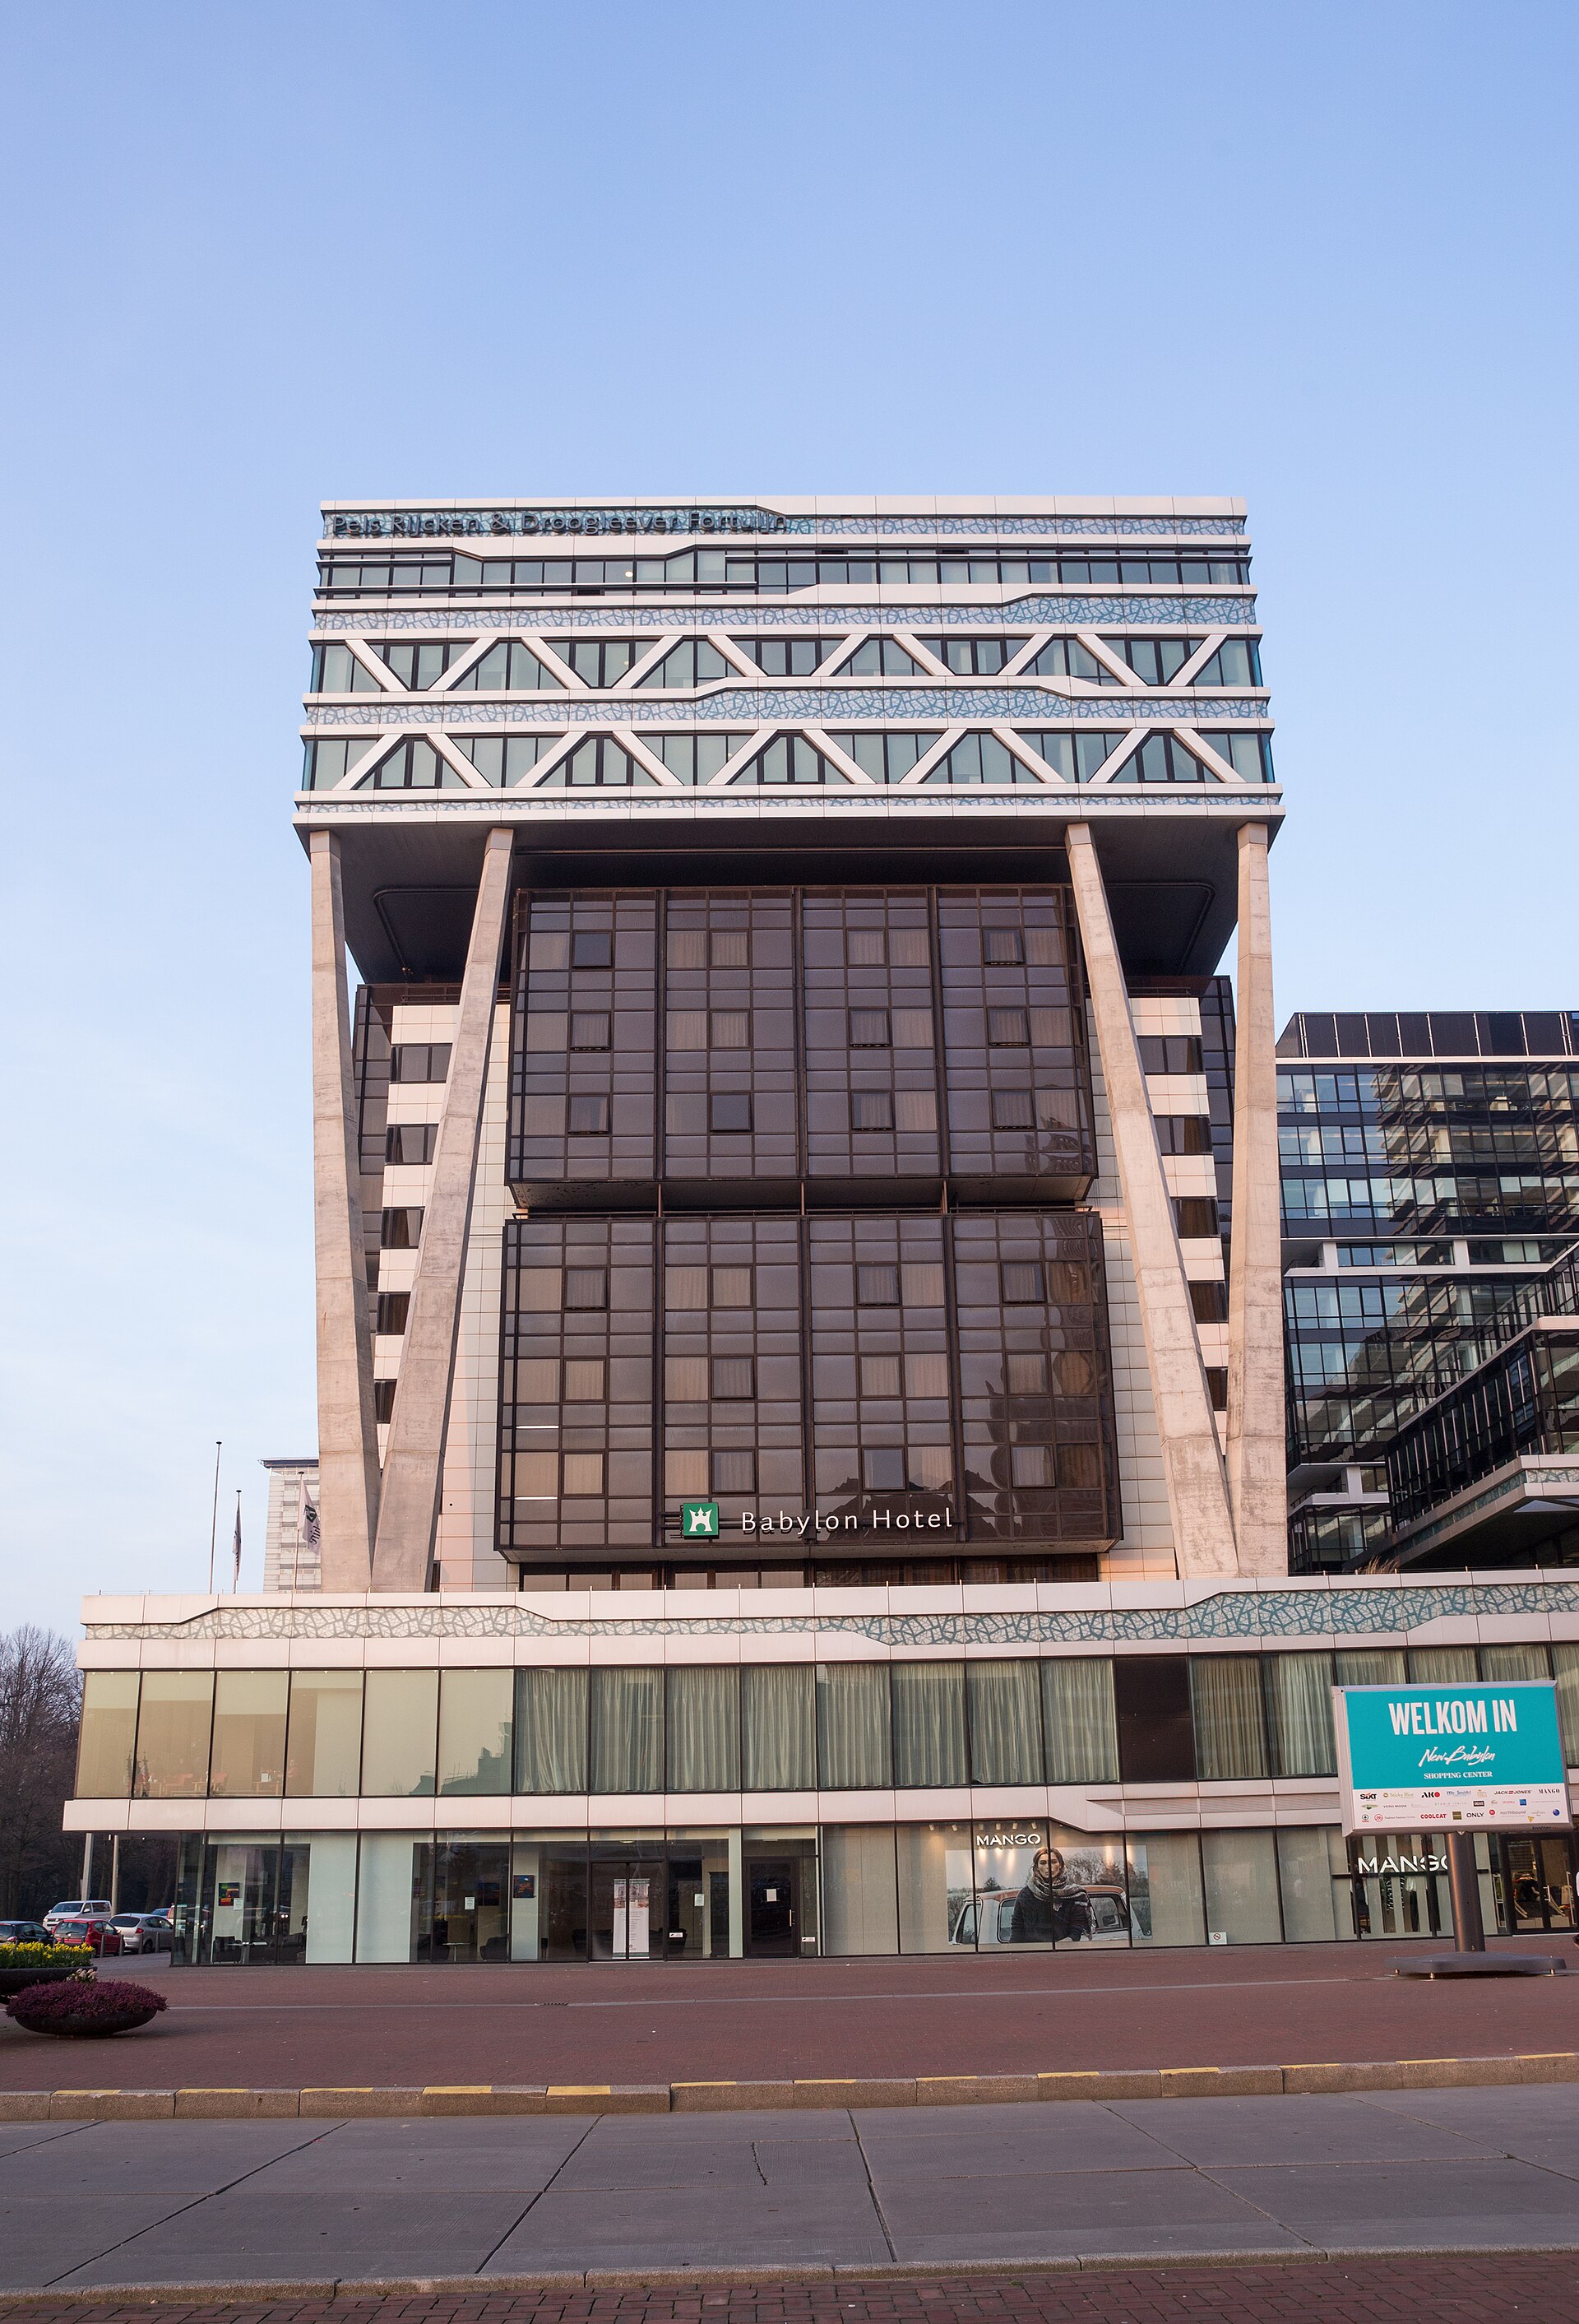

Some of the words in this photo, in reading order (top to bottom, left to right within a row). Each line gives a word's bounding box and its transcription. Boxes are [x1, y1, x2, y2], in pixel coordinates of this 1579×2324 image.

[333, 515, 380, 533] Pels
[491, 513, 510, 531] &
[522, 512, 678, 536] Droogleever
[688, 511, 787, 534] Fortuijn
[742, 1509, 858, 1535] Babylon
[873, 1507, 952, 1529] Hotel
[1388, 1700, 1488, 1736] WELKOM
[1492, 1699, 1517, 1733] IN
[1418, 1746, 1447, 1768] New
[1443, 1745, 1496, 1766] Babylon
[1424, 1771, 1461, 1779] SHOPPING
[976, 1833, 1041, 1847] MANGO
